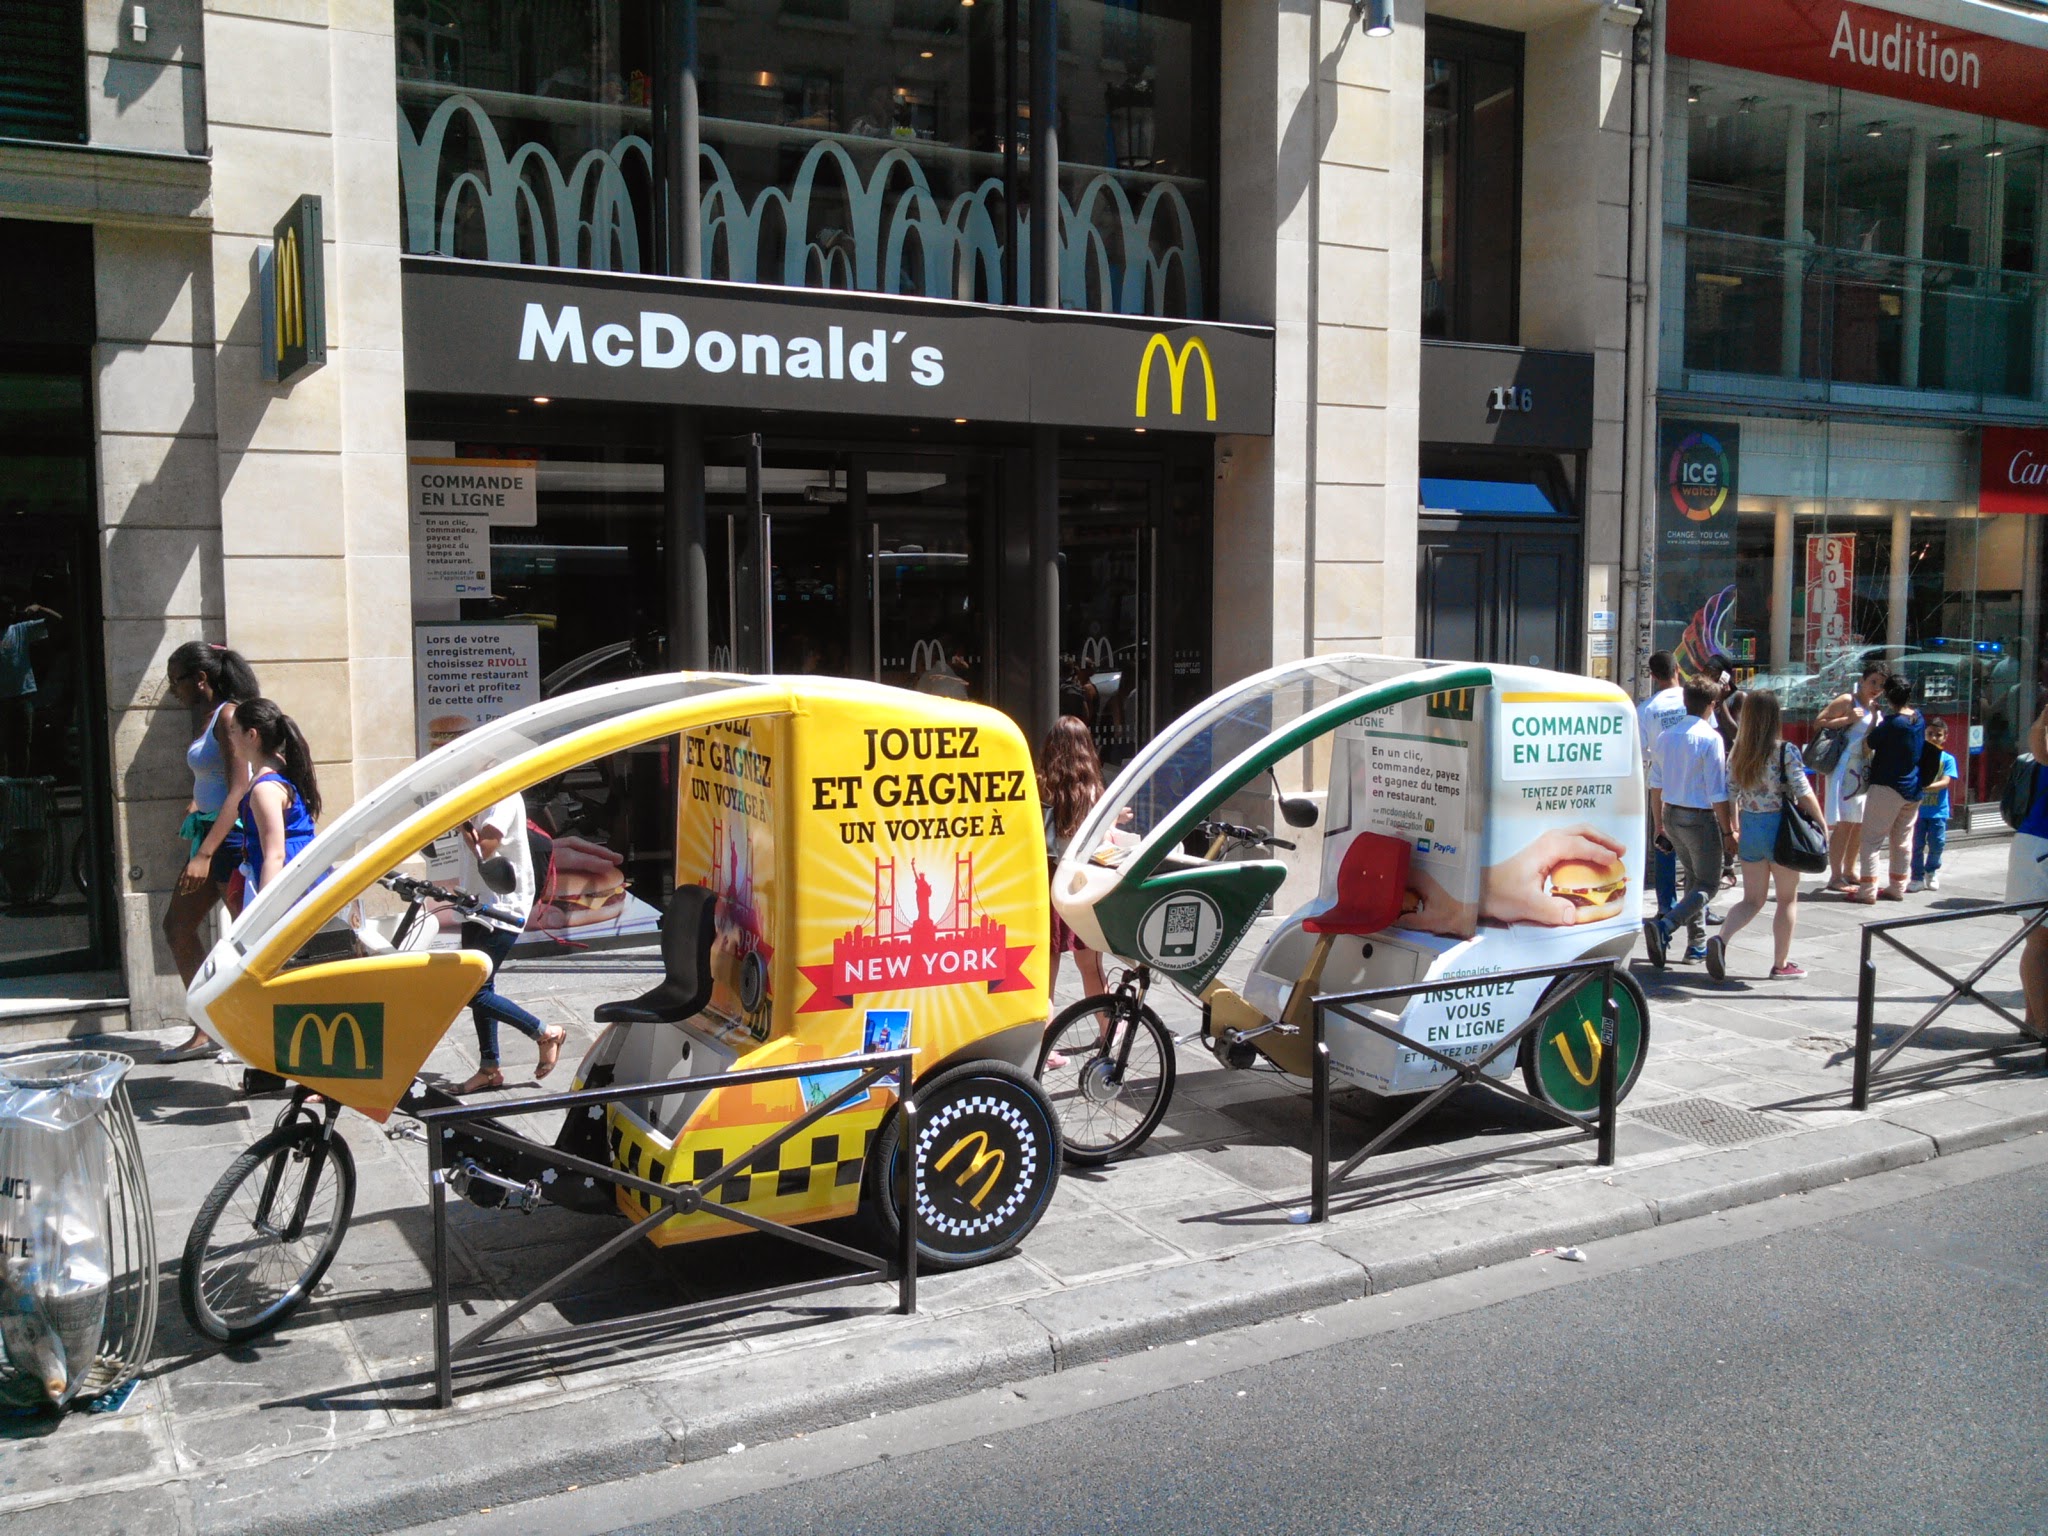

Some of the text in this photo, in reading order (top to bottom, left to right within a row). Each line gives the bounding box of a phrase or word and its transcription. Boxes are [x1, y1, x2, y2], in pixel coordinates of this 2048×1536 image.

[1829, 10, 1979, 88] Audition
[519, 303, 945, 386] McDonald's
[1490, 386, 1532, 412] 116
[421, 474, 523, 490] COMMANDE
[422, 492, 505, 507] EN LIGNE
[1683, 487, 1717, 496] watch
[452, 519, 468, 527] clic,
[1667, 530, 1730, 539] CHANGE. YOU CAN.
[426, 635, 500, 644] Lors de votre
[427, 646, 516, 657] enregistrement,
[427, 658, 527, 668] choisissez RIVOLI
[427, 671, 528, 681] comme restaurant
[428, 683, 521, 693] favori et profitez
[428, 695, 503, 705] de cette offre
[1511, 715, 1623, 736] COMMANDE
[864, 727, 980, 771] JOUEZ
[1372, 746, 1423, 761] En un clic,
[1513, 742, 1603, 764] EN LIGNE
[687, 736, 771, 788] ET GAGNEZ
[1372, 761, 1460, 782] commandez, payez
[812, 770, 1026, 811] ET GAGNEZ
[1372, 775, 1460, 797] et gagnez du temps
[1522, 784, 1612, 799] TENTEZ DE PARTIR
[692, 778, 710, 803] UN
[714, 784, 758, 819] VOYAGE
[1372, 789, 1437, 806] en restaurant.
[1536, 797, 1596, 811] À NEW YORK
[1380, 807, 1423, 820] mcdonalds.fr
[839, 808, 1006, 844] UN VOYAGE À
[1433, 842, 1456, 855] PayPal
[1153, 931, 1221, 969] COMMANDE EN LIGNE
[1192, 892, 1272, 990] FLASHEZ, CLIQUEZ, COMMANDEZ
[845, 947, 998, 983] NEW YORK
[1443, 965, 1502, 980] mcdonalds.fr
[1423, 981, 1515, 1004] INSCRIVEZ
[1446, 1002, 1491, 1020] VOUS
[1428, 1019, 1505, 1041] EN LIGNE
[1404, 1053, 1418, 1063] ET
[1465, 1044, 1477, 1055] DE
